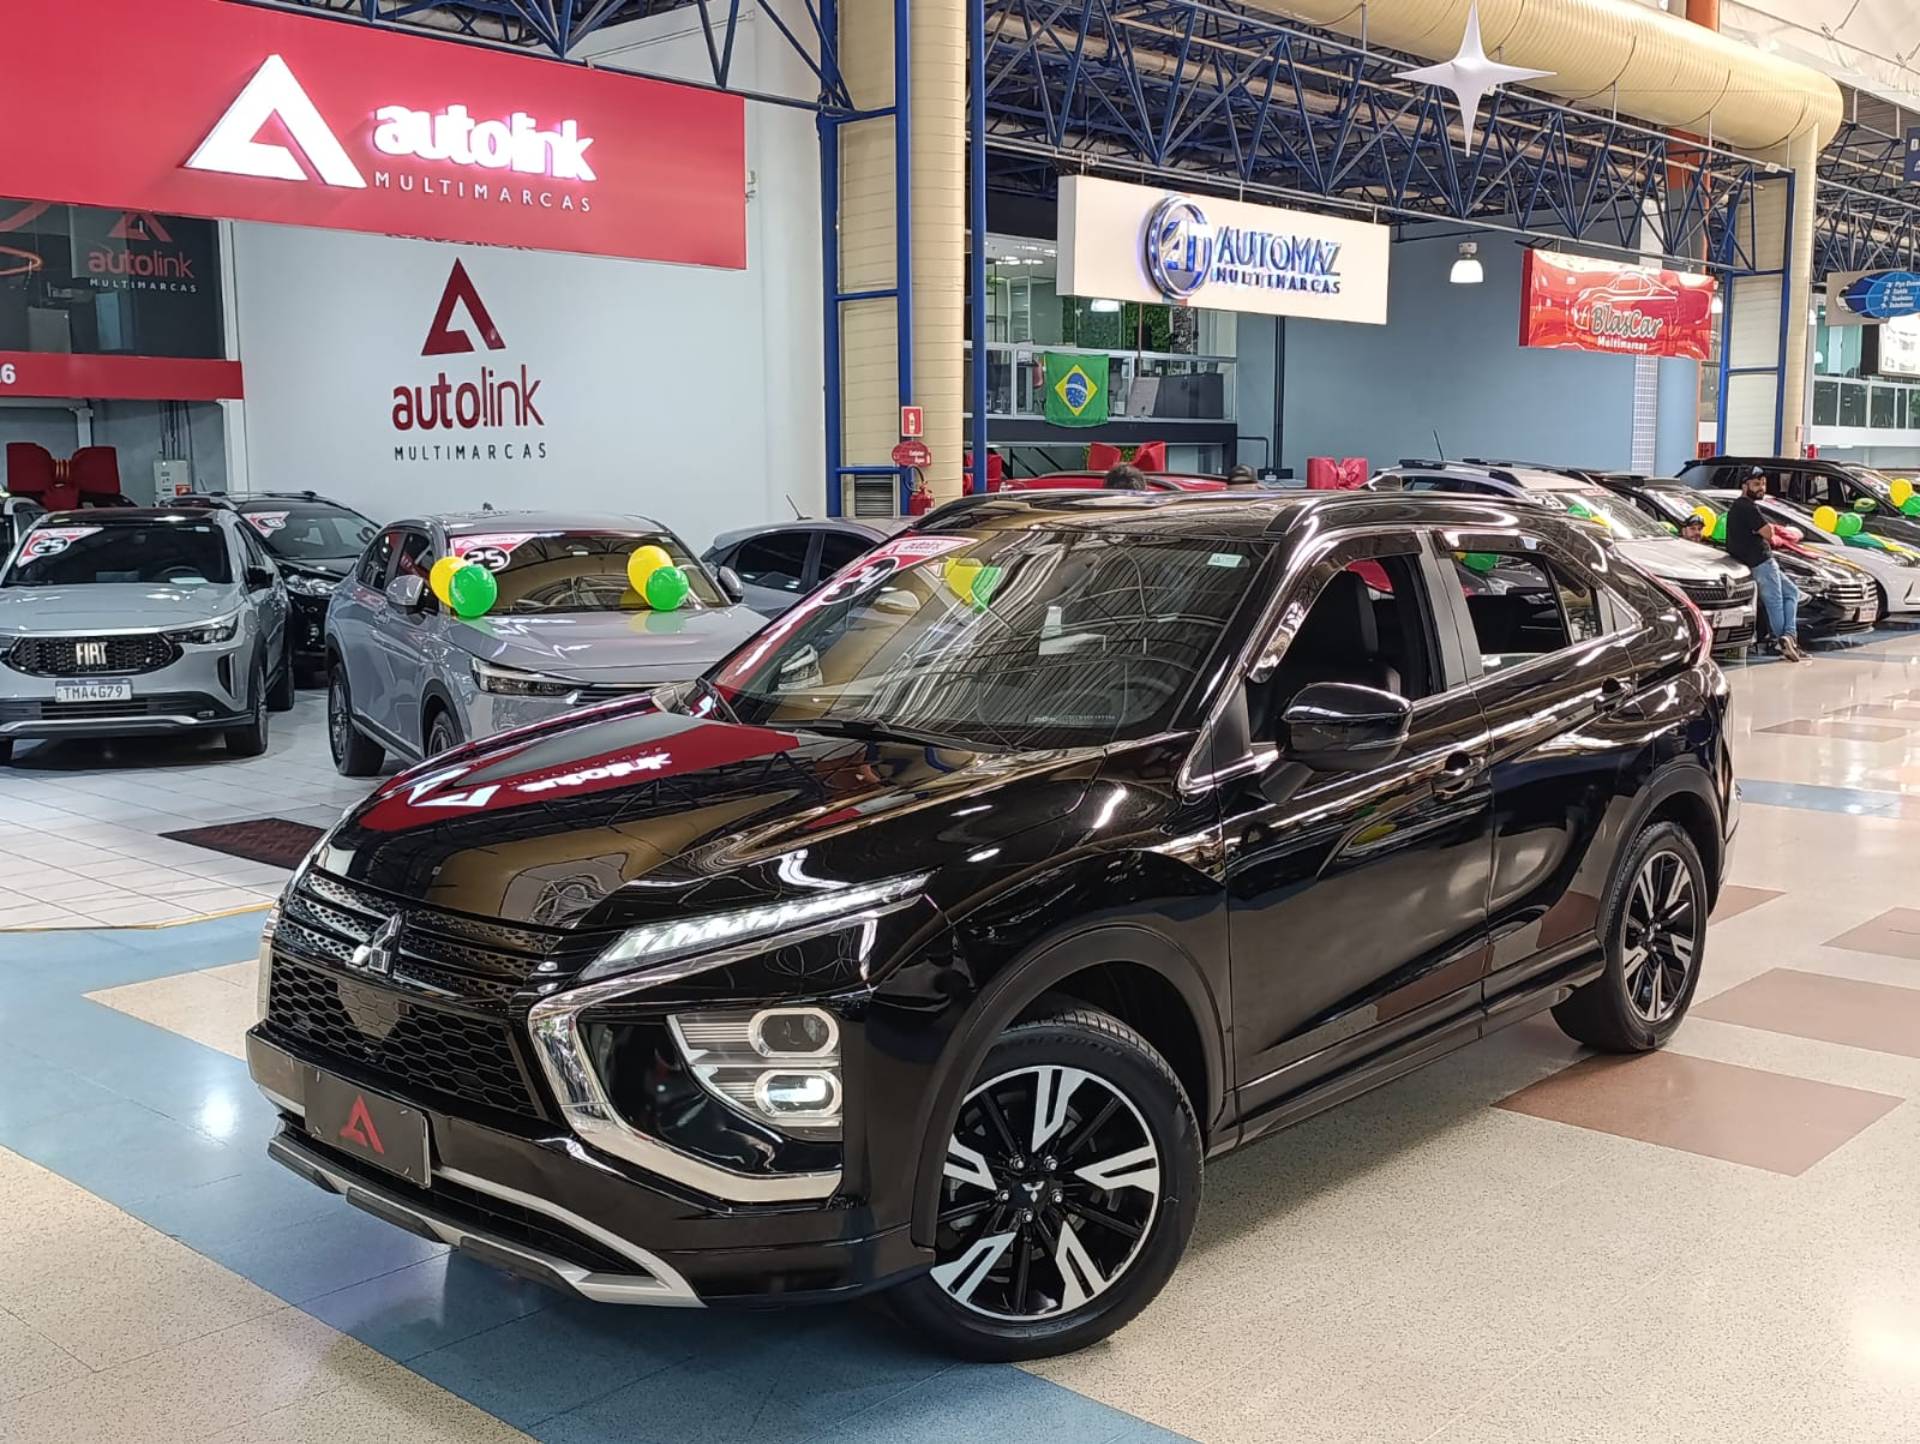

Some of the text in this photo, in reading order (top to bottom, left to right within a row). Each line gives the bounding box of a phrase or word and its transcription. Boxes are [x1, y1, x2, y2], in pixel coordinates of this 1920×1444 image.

[373, 104, 597, 182] autolink
[375, 171, 591, 212] MULTIMARCAS
[87, 249, 195, 279] autolink
[1217, 226, 1342, 277] AUTOMAZ
[89, 278, 198, 293] MULTIMARCAS
[1213, 267, 1341, 295] MULTIMARCAS
[1591, 302, 1663, 339] BlasCar
[392, 364, 544, 431] autolink
[394, 442, 547, 461] MULTIMARCAS
[33, 539, 65, 553] 25
[468, 550, 505, 567] 25
[76, 642, 108, 665] FIAT
[63, 685, 123, 700] TMA4G79
